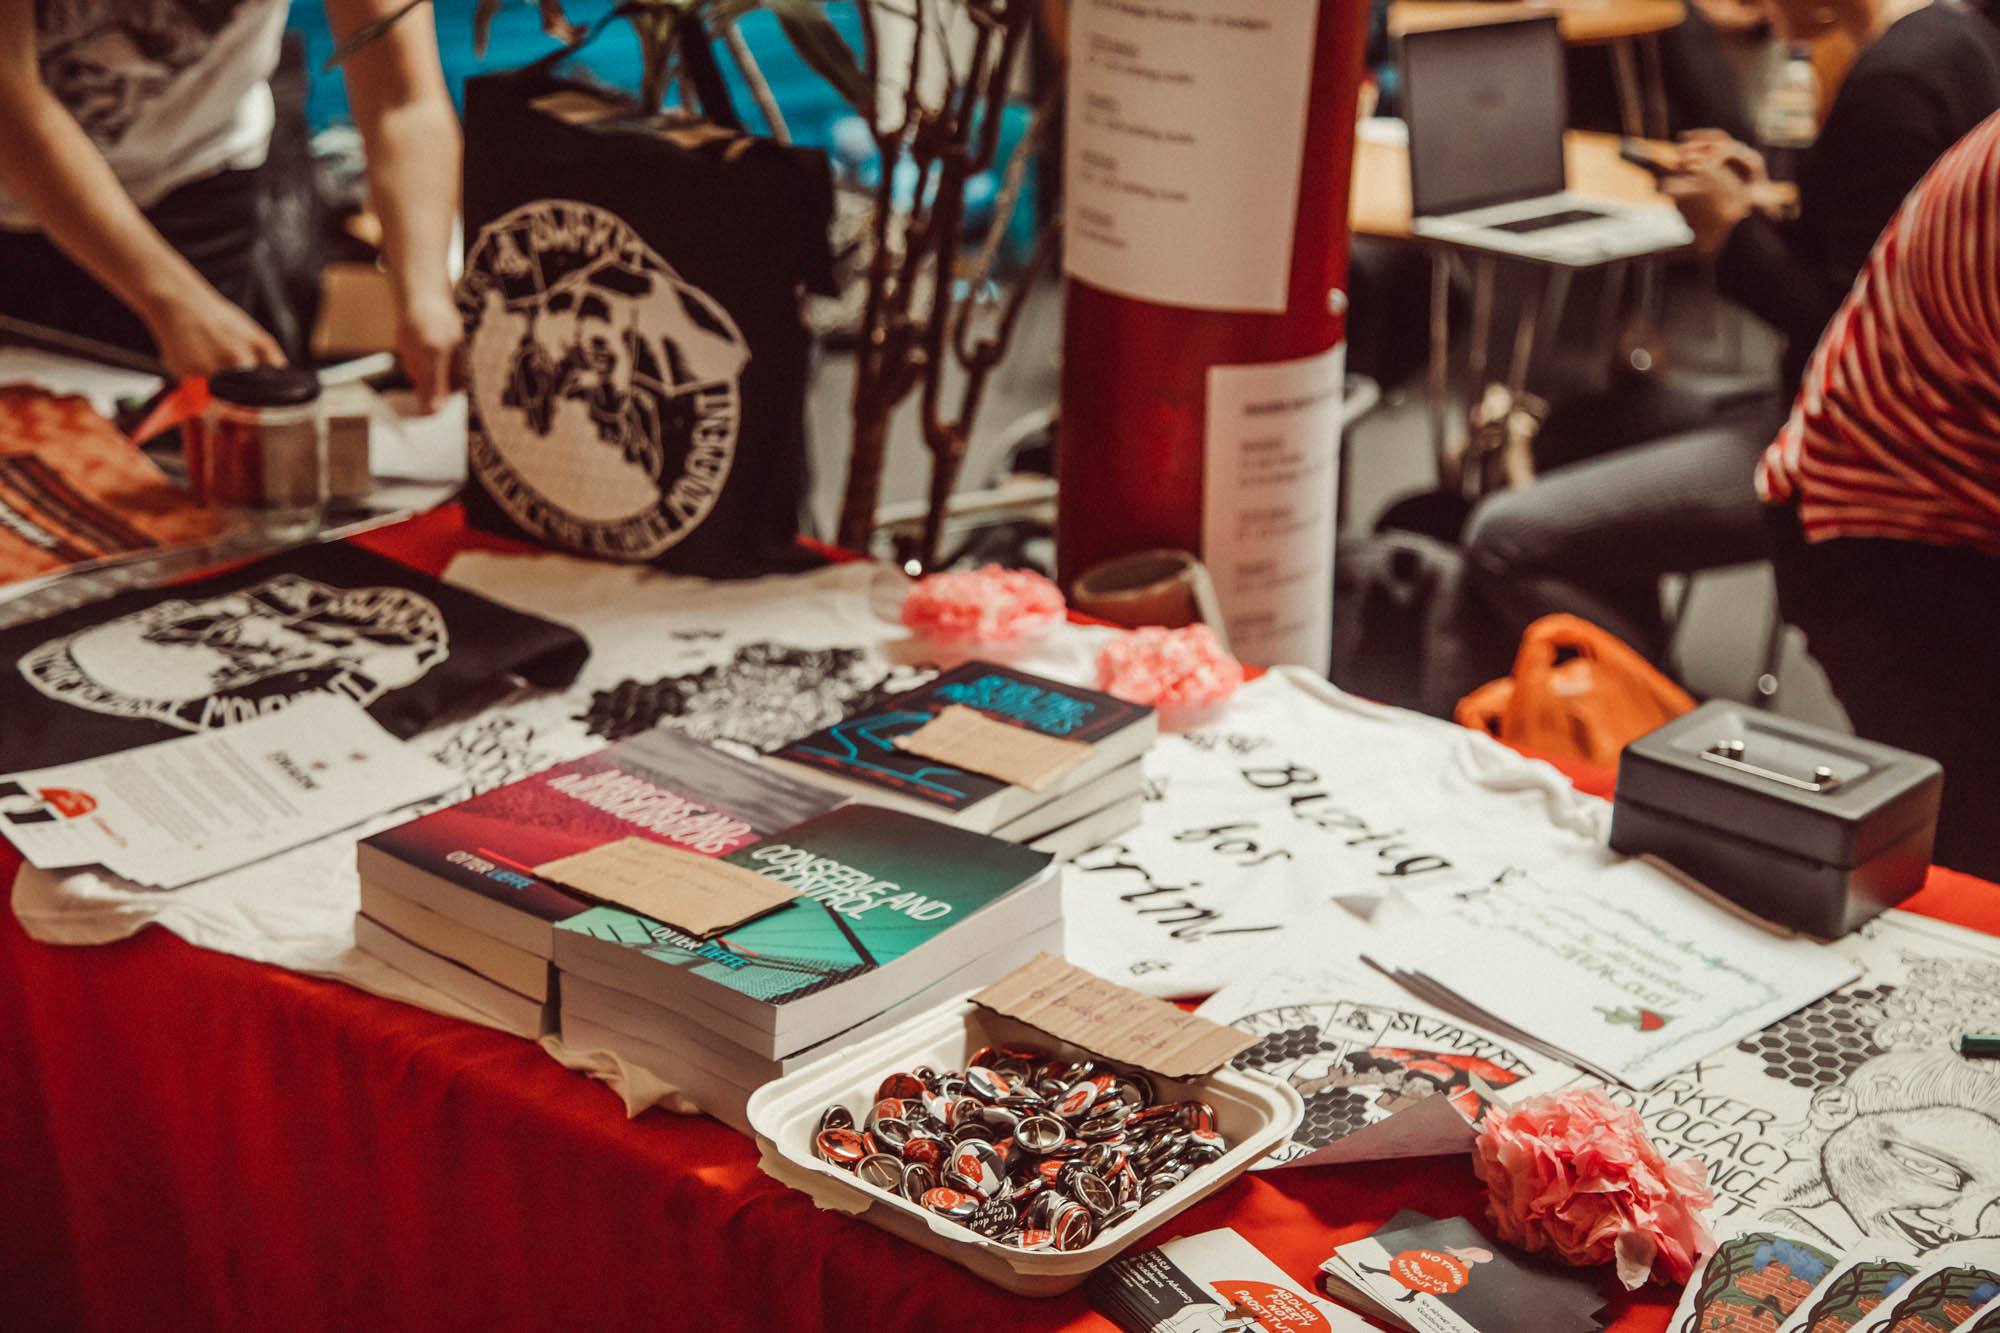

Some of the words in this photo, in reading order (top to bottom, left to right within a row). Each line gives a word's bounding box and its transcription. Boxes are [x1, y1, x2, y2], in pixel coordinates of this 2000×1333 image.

[751, 843, 901, 895] CONSERVE
[870, 886, 953, 922] AND
[1391, 1011, 1535, 1075] SWARM
[1652, 1078, 1777, 1137] RKER
[1420, 1252, 1463, 1285] NOTHING
[1265, 1294, 1312, 1327] POVERTY
[1267, 1304, 1294, 1321] NOT
[1272, 1288, 1319, 1322] ABOLISH
